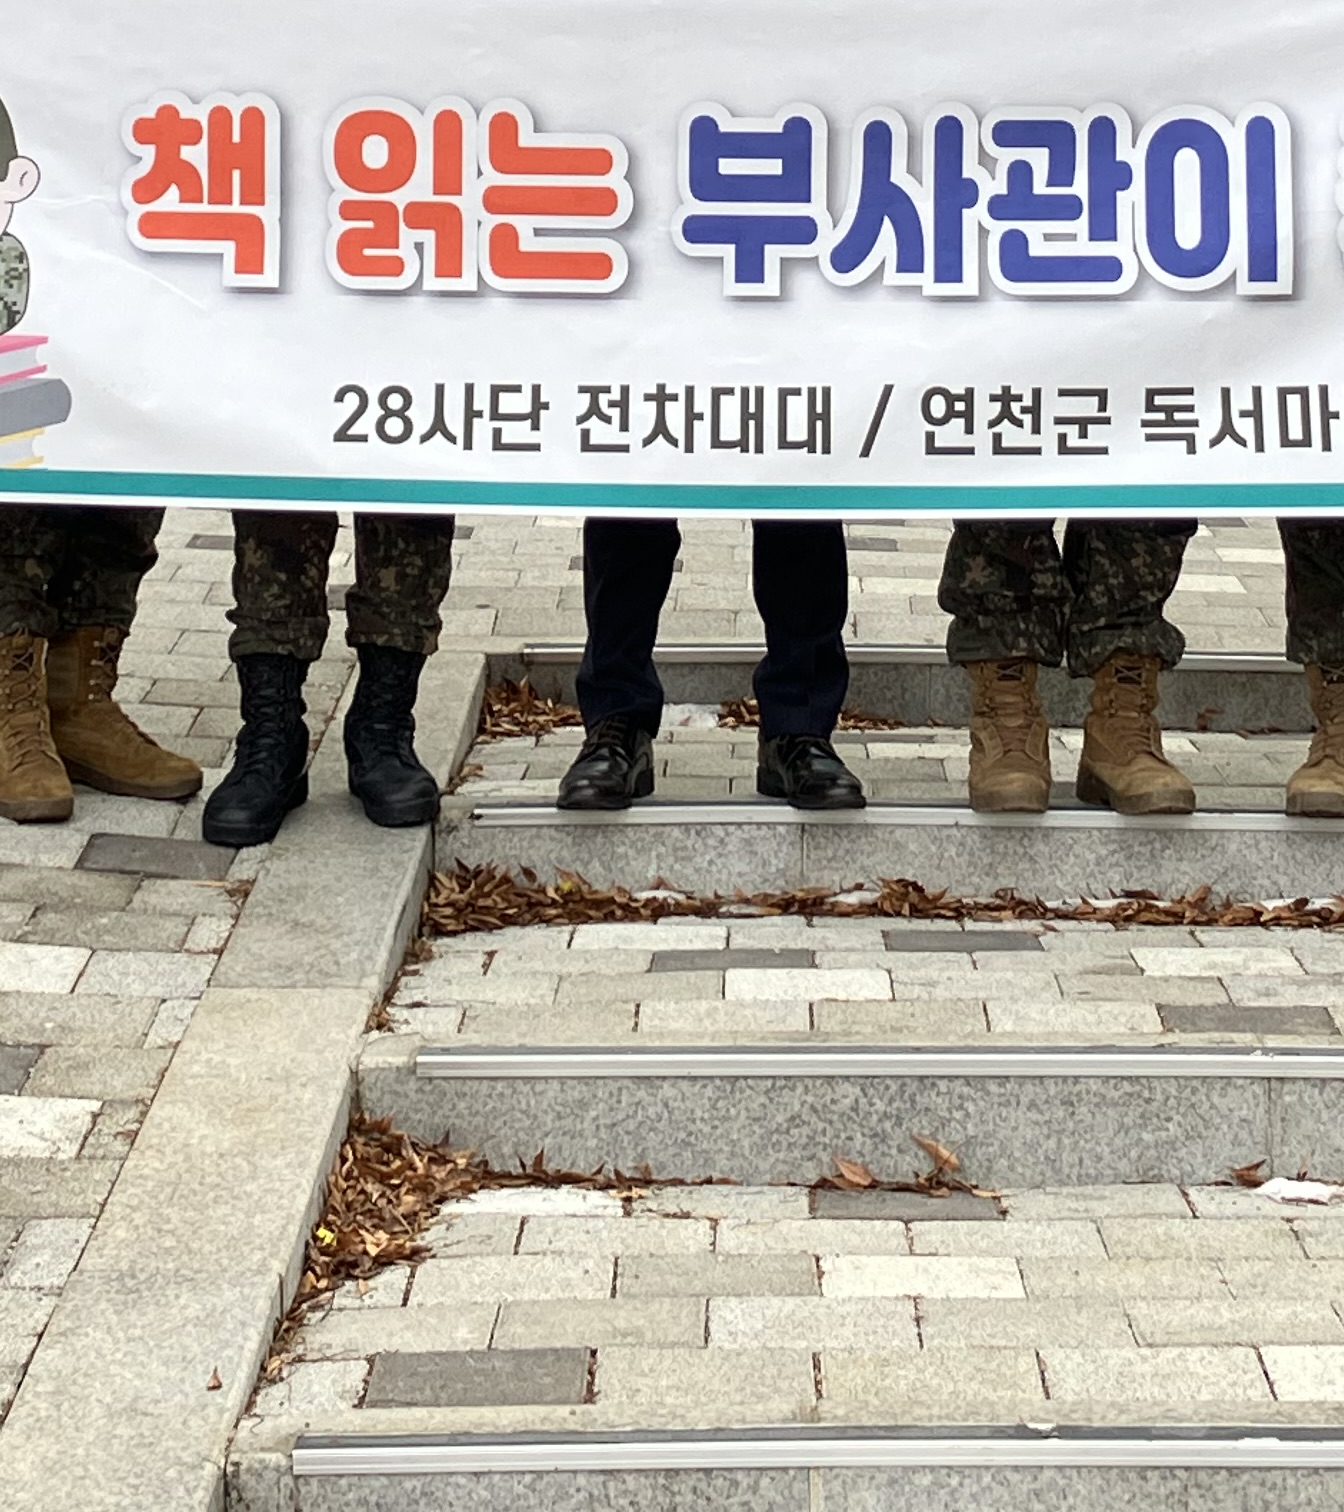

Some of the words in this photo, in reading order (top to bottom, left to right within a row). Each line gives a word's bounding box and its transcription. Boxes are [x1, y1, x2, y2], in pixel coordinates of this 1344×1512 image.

[131, 103, 266, 275] 책
[333, 108, 618, 280] 읽는
[682, 114, 1280, 284] 부사관이
[332, 381, 550, 452] 28사단
[575, 383, 833, 456] 전차대대
[859, 383, 895, 458] /
[920, 384, 1112, 456] 연천군
